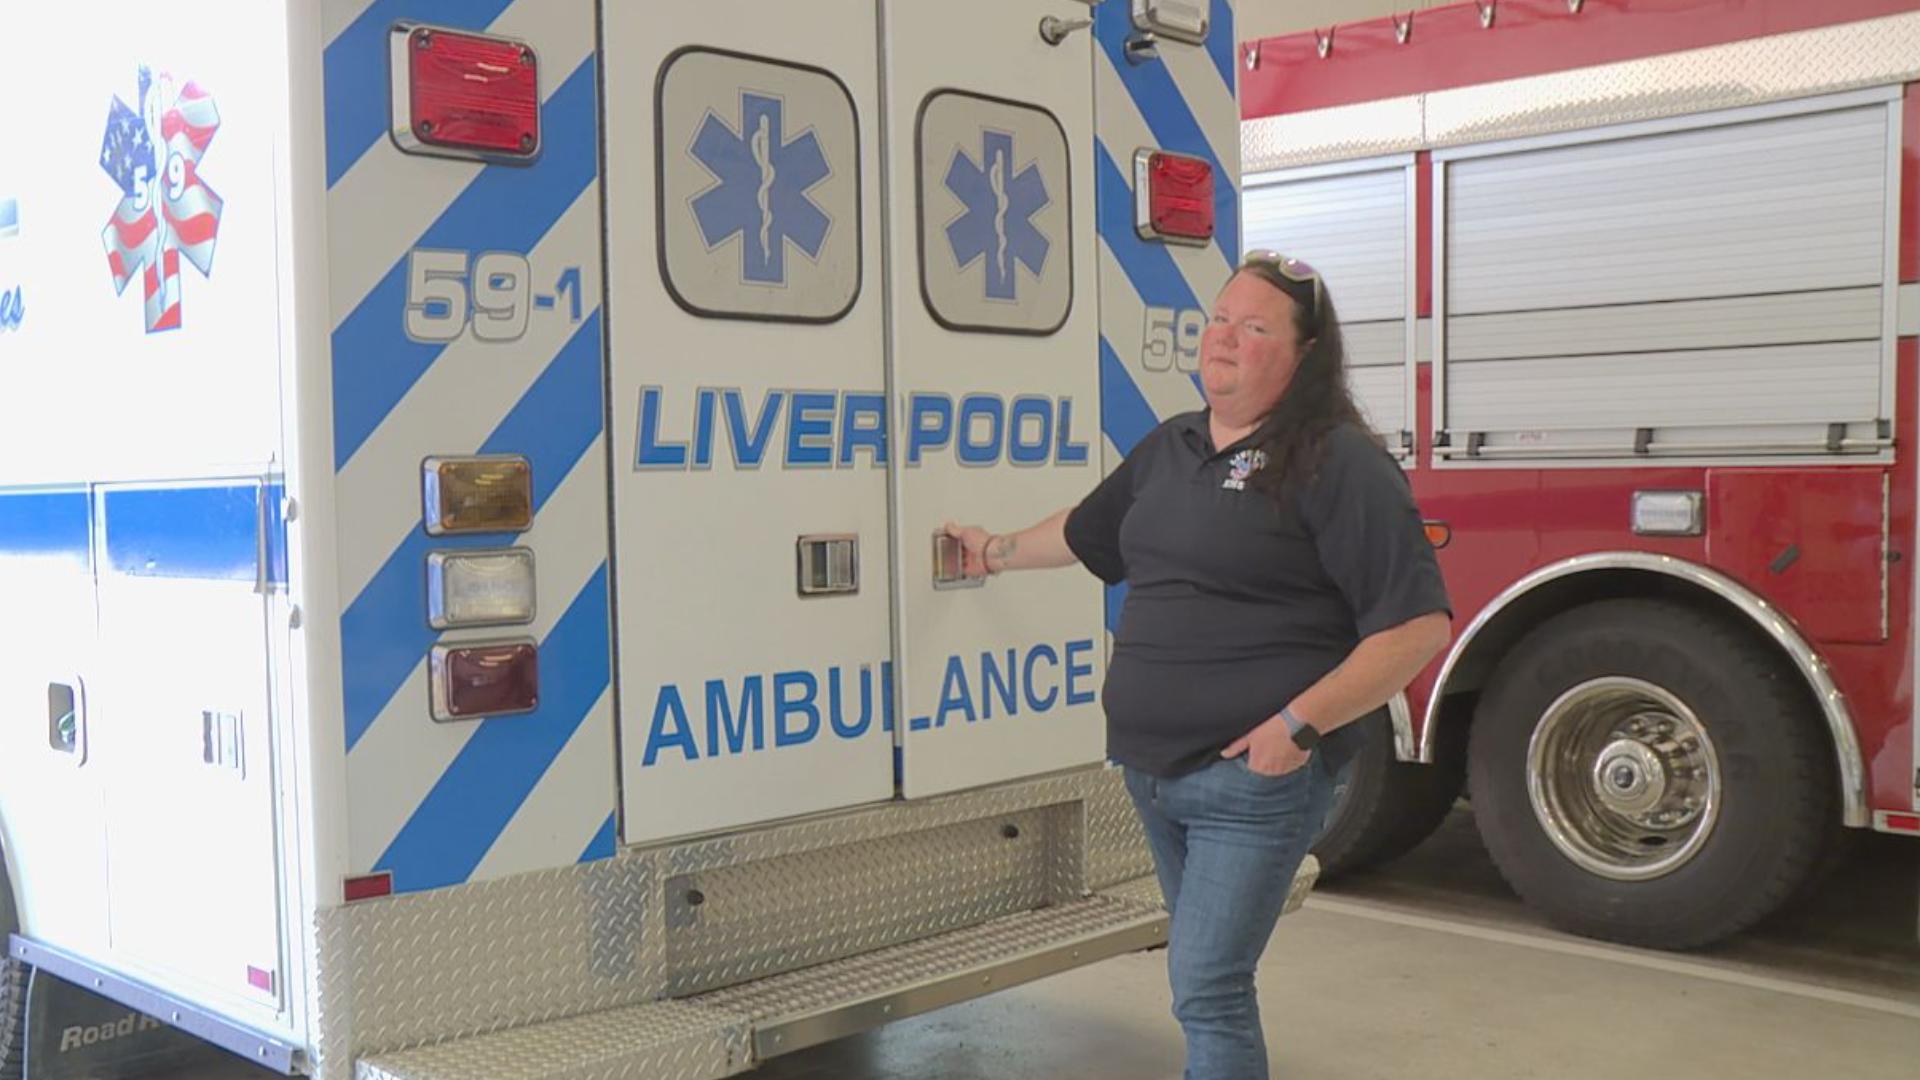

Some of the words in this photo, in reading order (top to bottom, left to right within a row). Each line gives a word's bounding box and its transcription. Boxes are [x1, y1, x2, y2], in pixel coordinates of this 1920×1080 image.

[404, 248, 582, 344] 59-1
[633, 385, 1089, 471] LIVERPOOL
[641, 639, 1096, 767] AMBULANCE
[60, 1012, 137, 1052] Road
